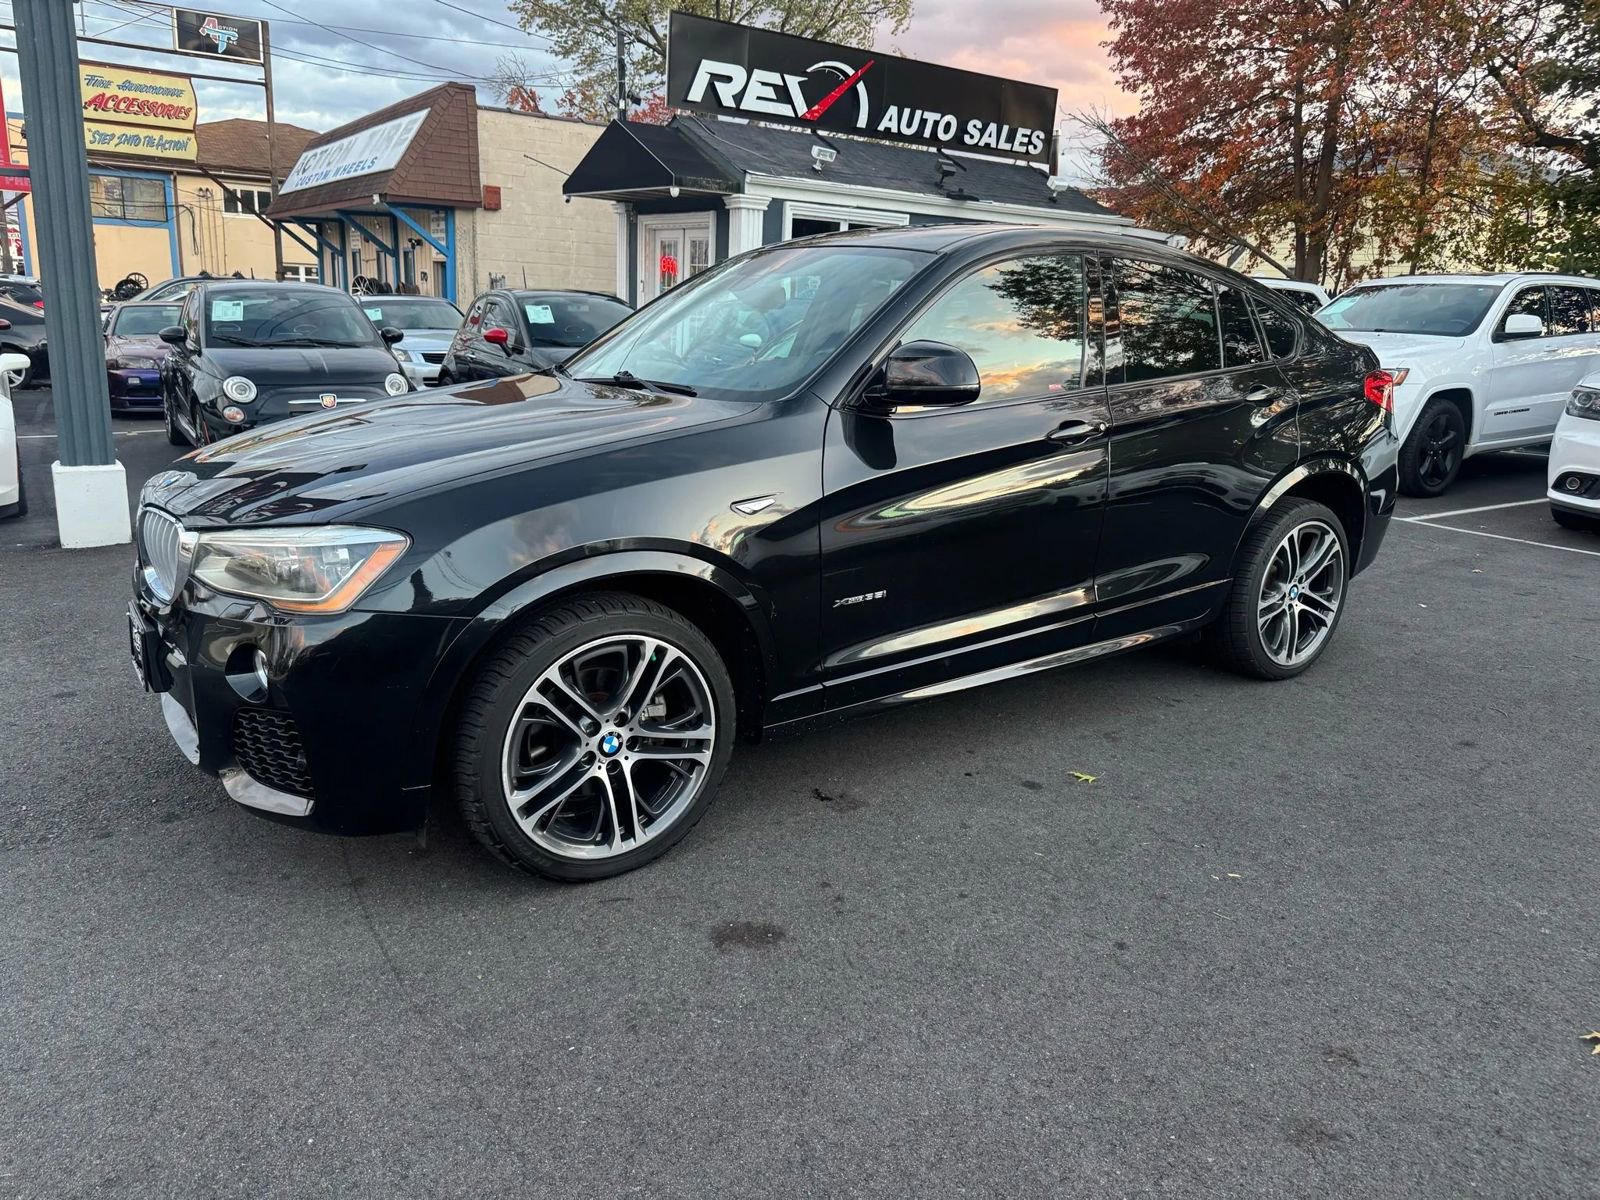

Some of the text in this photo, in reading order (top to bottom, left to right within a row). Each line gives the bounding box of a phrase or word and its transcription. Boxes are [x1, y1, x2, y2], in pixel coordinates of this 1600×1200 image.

[83, 92, 192, 120] ACCESSORIES
[687, 58, 875, 121] REV
[115, 133, 142, 148] INTO
[142, 135, 157, 148] THE
[292, 116, 419, 177] ACTION TIRE
[877, 104, 1046, 155] AUTO SALES
[295, 156, 378, 188] CUSTOM WHEELS
